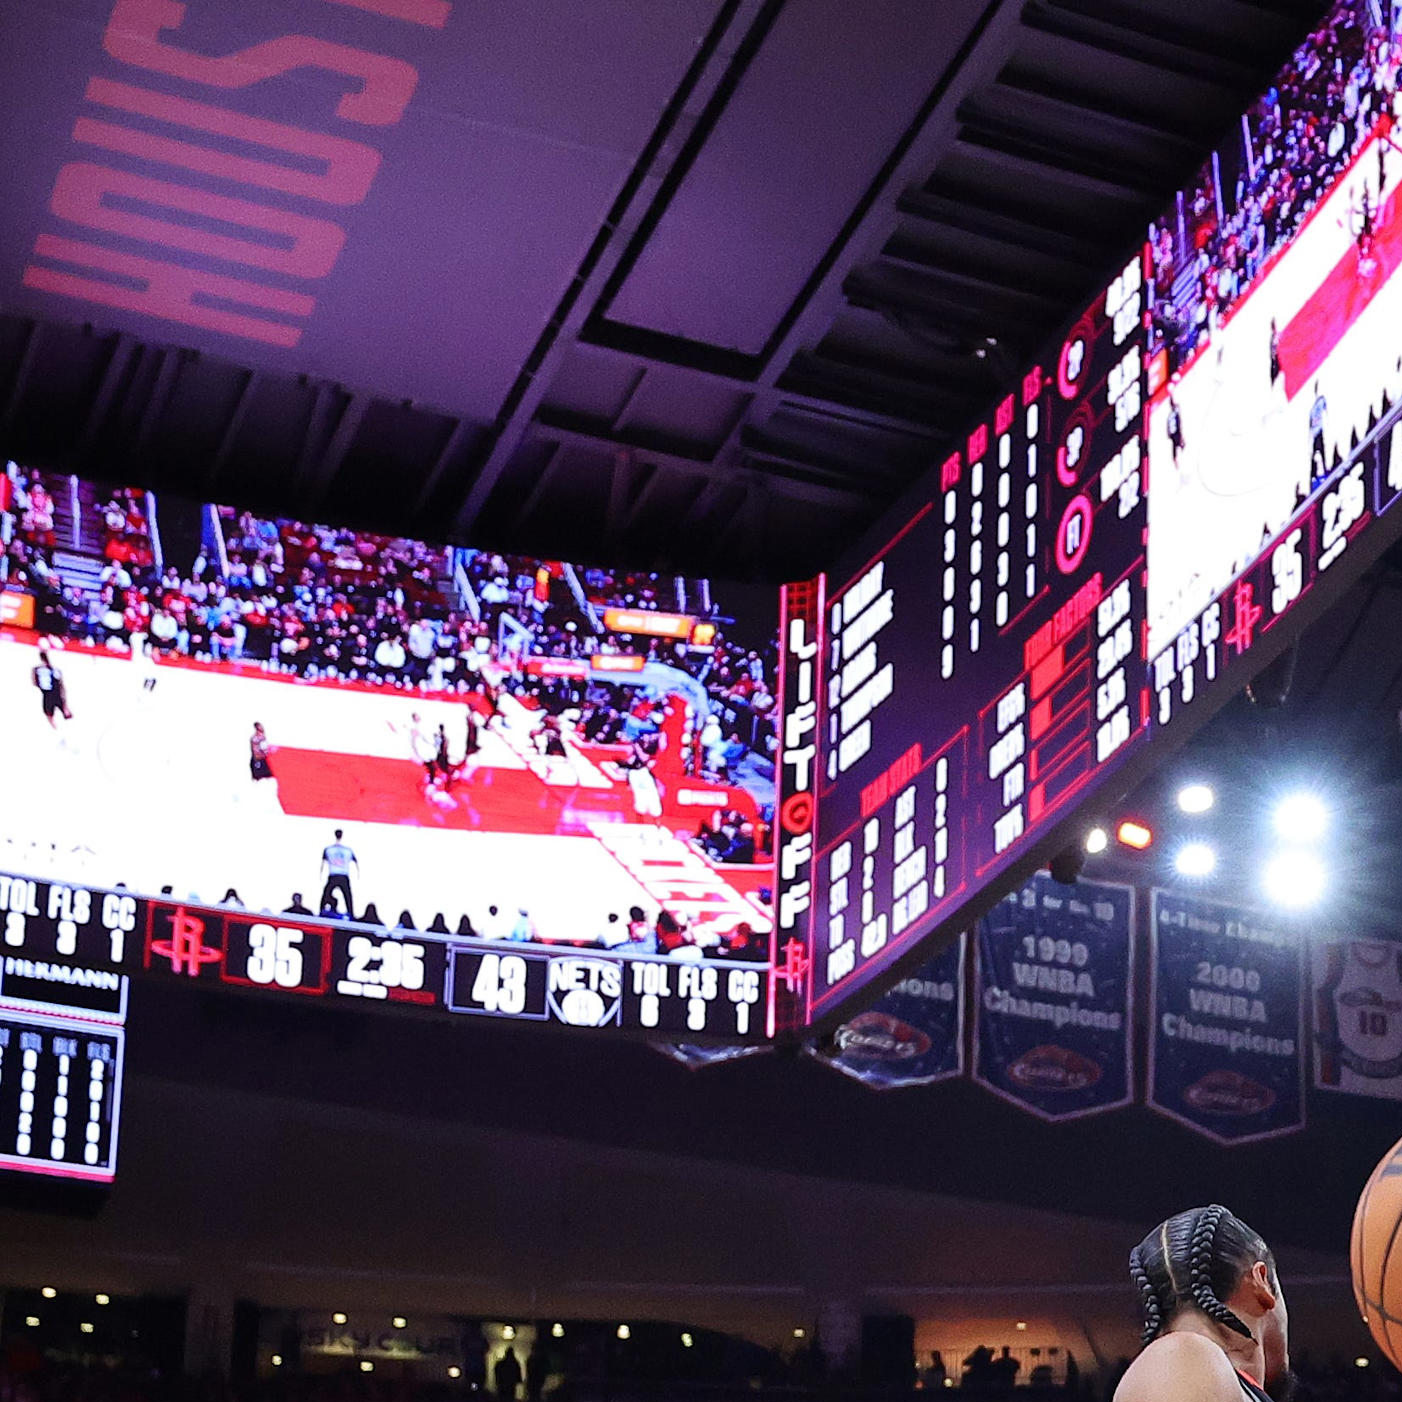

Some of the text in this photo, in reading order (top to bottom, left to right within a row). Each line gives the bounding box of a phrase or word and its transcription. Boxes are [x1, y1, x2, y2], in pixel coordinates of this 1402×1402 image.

[1272, 528, 1302, 614] 35
[1207, 643, 1215, 680] 1
[47, 885, 91, 925] FLS
[102, 893, 136, 931] CC
[110, 929, 124, 963] 1
[247, 923, 303, 987] 35
[1022, 935, 1090, 967] 1999
[472, 953, 527, 1015] 43
[549, 960, 621, 998] NETS
[631, 962, 759, 1005] TOL FLS CC
[1013, 962, 1095, 997] WNBA
[1197, 962, 1261, 992] 2000
[736, 1002, 749, 1035] 1
[985, 987, 1121, 1030] Champions
[1190, 989, 1267, 1023] WNBA
[1358, 1011, 1387, 1036] 10
[1162, 1013, 1295, 1055] Champions
